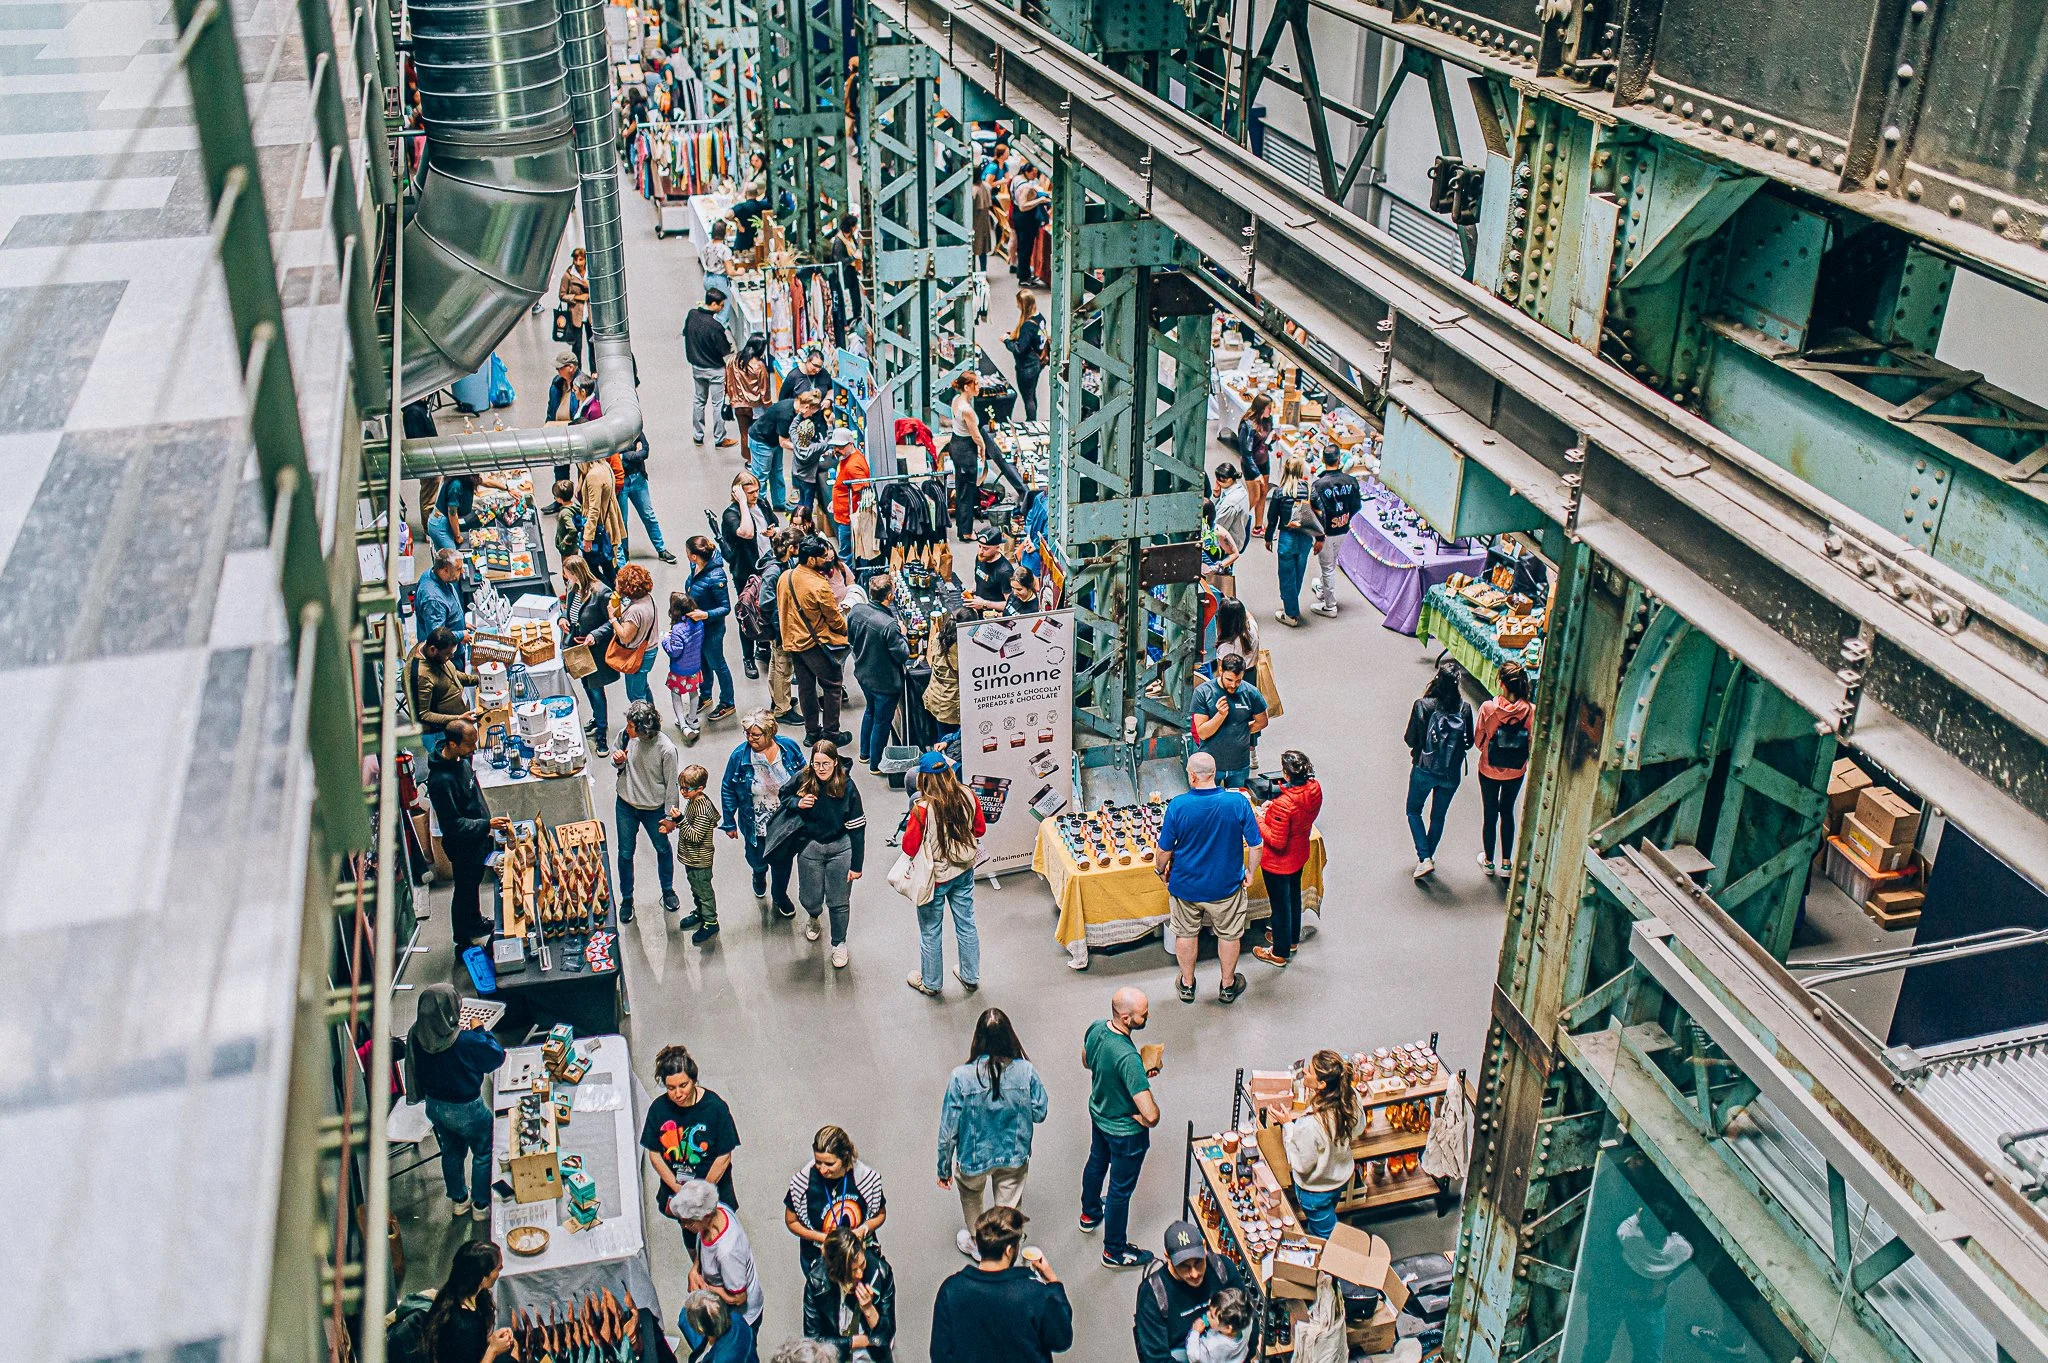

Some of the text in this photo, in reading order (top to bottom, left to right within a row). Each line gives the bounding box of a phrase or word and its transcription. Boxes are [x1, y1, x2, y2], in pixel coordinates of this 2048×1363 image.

[1324, 484, 1352, 498] PRAY
[971, 662, 1011, 679] allo
[973, 668, 1062, 692] simonne
[973, 691, 1015, 704] TARTINADES
[1023, 685, 1062, 696] CHOCOLAT
[977, 699, 1008, 710] SPREADS
[1016, 692, 1058, 704] CHOCOLATE
